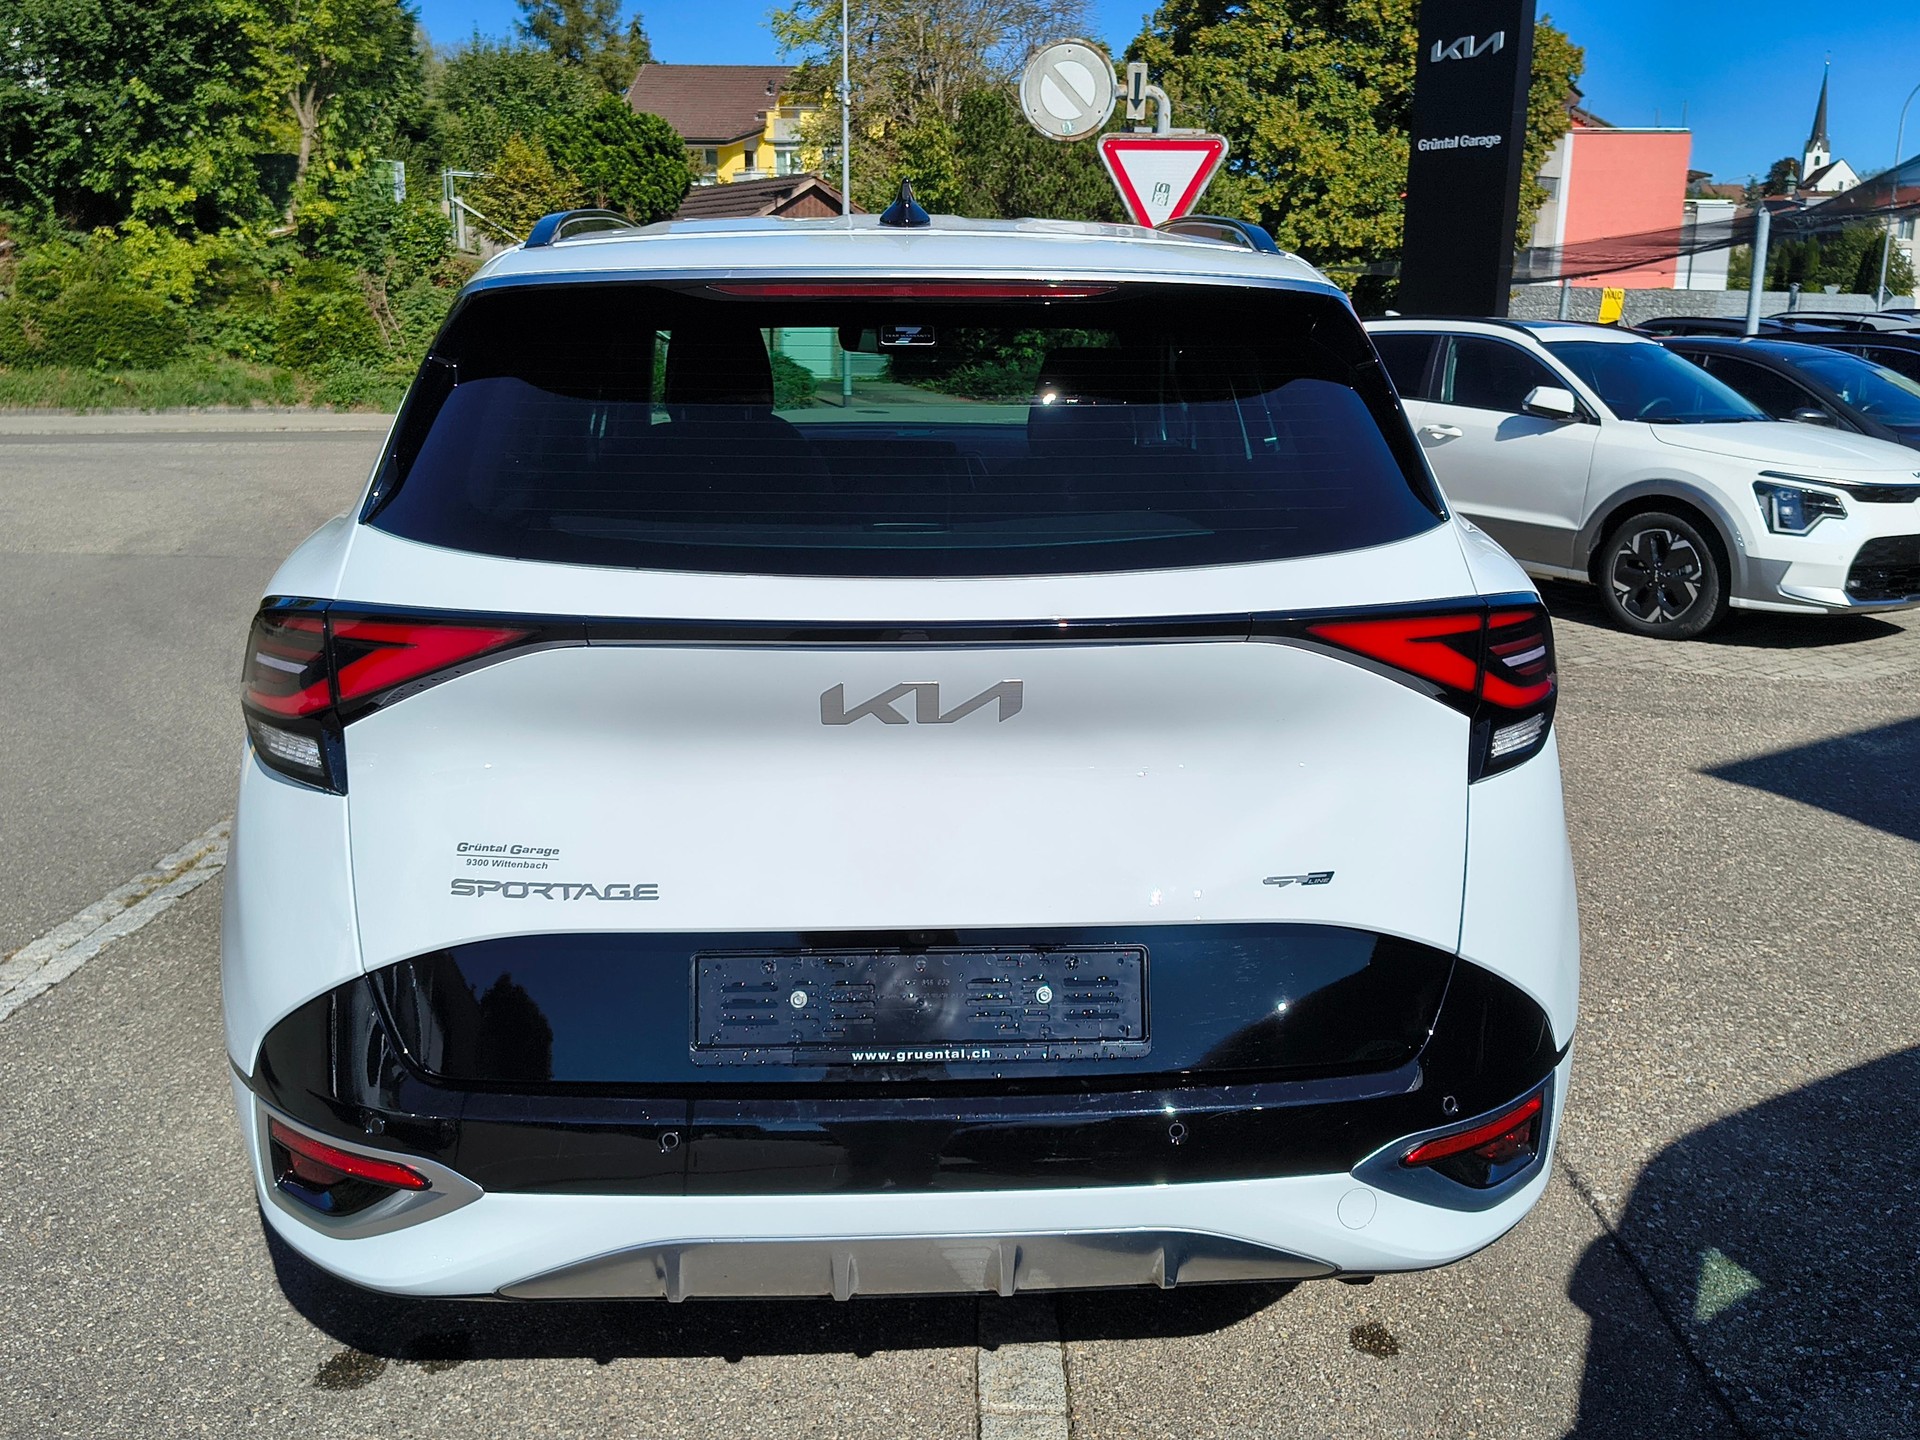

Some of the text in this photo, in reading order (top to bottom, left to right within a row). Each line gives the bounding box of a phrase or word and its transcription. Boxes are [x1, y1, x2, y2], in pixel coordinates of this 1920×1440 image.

[1418, 134, 1501, 151] Grüntal Garage
[820, 679, 1023, 725] KIA
[456, 842, 560, 857] Grüntal Garage
[466, 858, 548, 869] 9300 Wittenbach
[450, 878, 660, 900] SPORTAGE
[851, 1048, 991, 1061] www.gruental.ch
